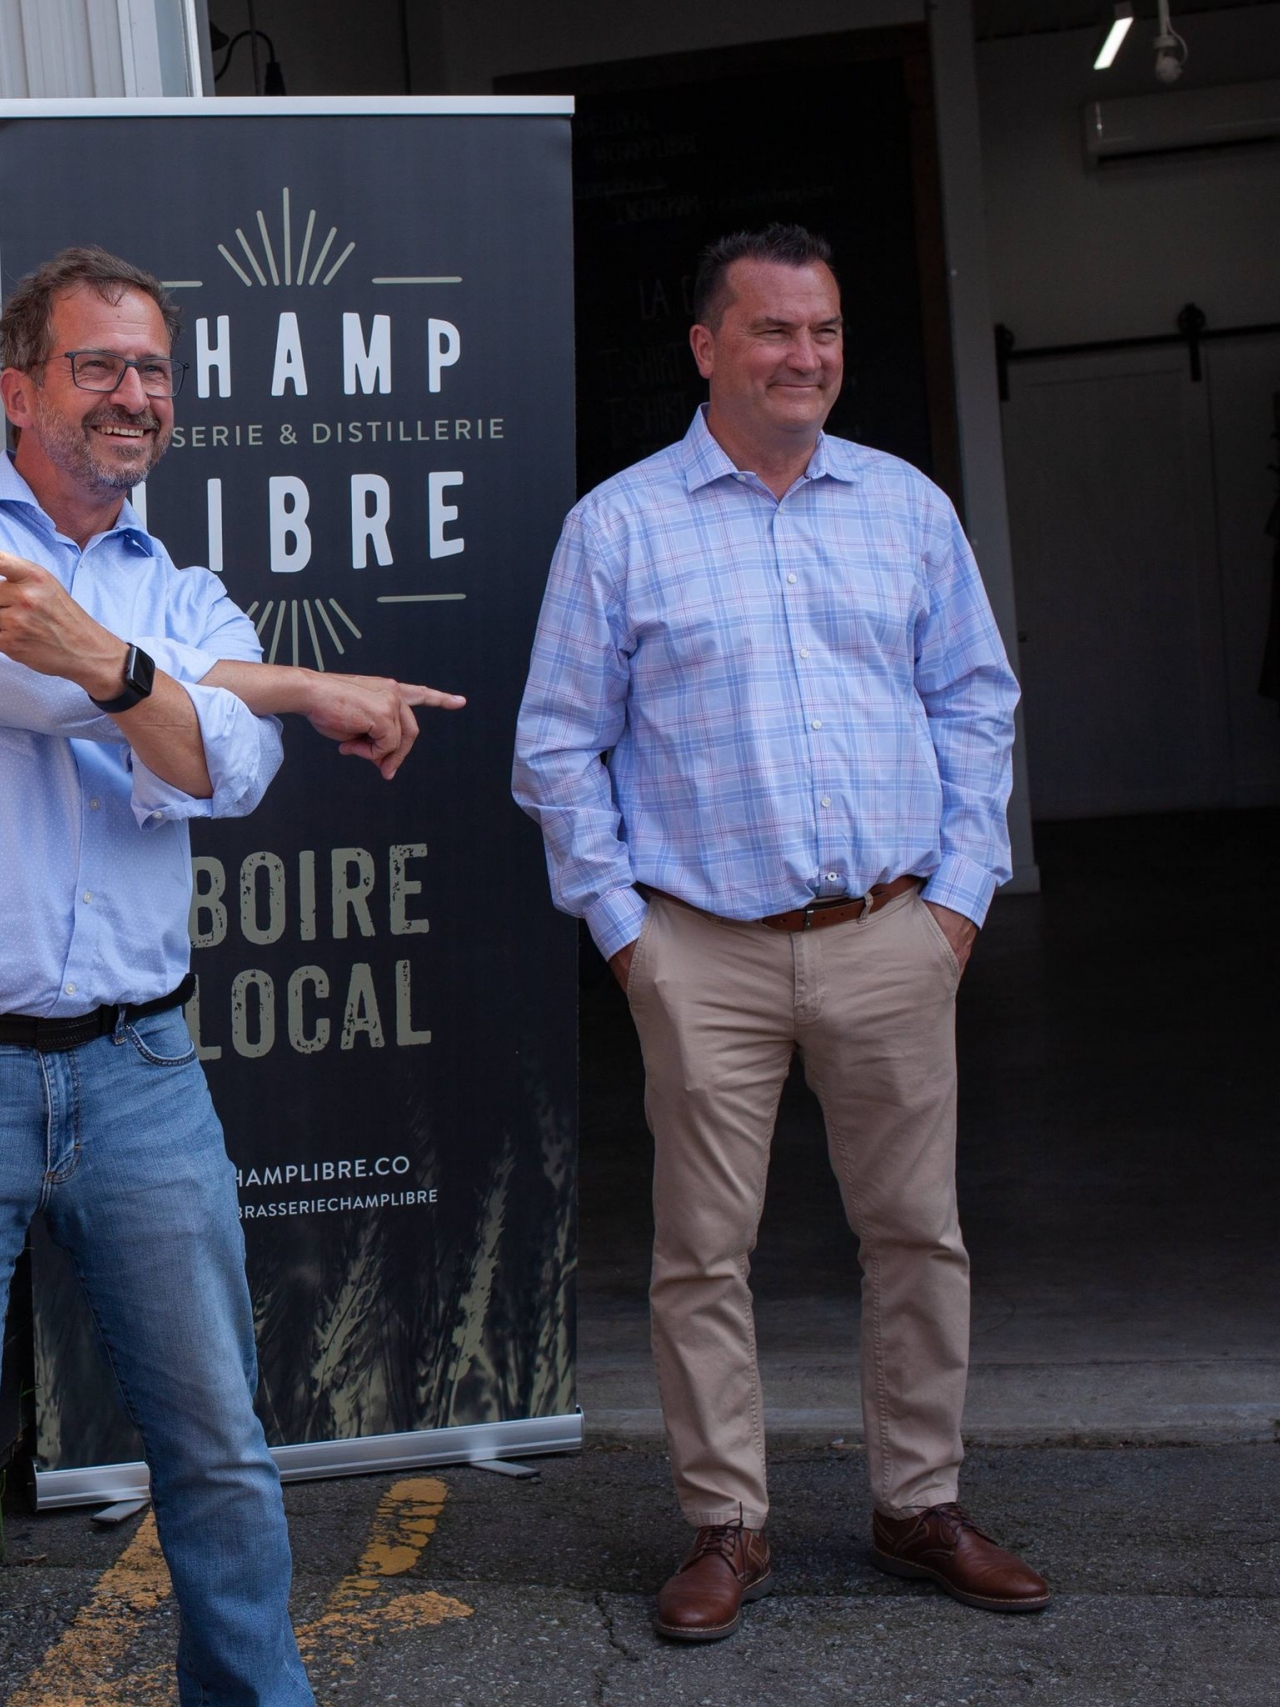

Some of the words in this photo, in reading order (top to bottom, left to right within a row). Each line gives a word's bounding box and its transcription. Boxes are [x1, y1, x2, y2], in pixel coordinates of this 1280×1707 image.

[195, 312, 461, 398] HAMP
[171, 425, 263, 448] SERIE
[279, 424, 298, 445] &
[312, 418, 504, 444] DISTILLERIE
[188, 843, 430, 949] BOIRE
[185, 960, 432, 1061] LOCAL
[235, 1155, 410, 1188] HAMPLIBRE.CO
